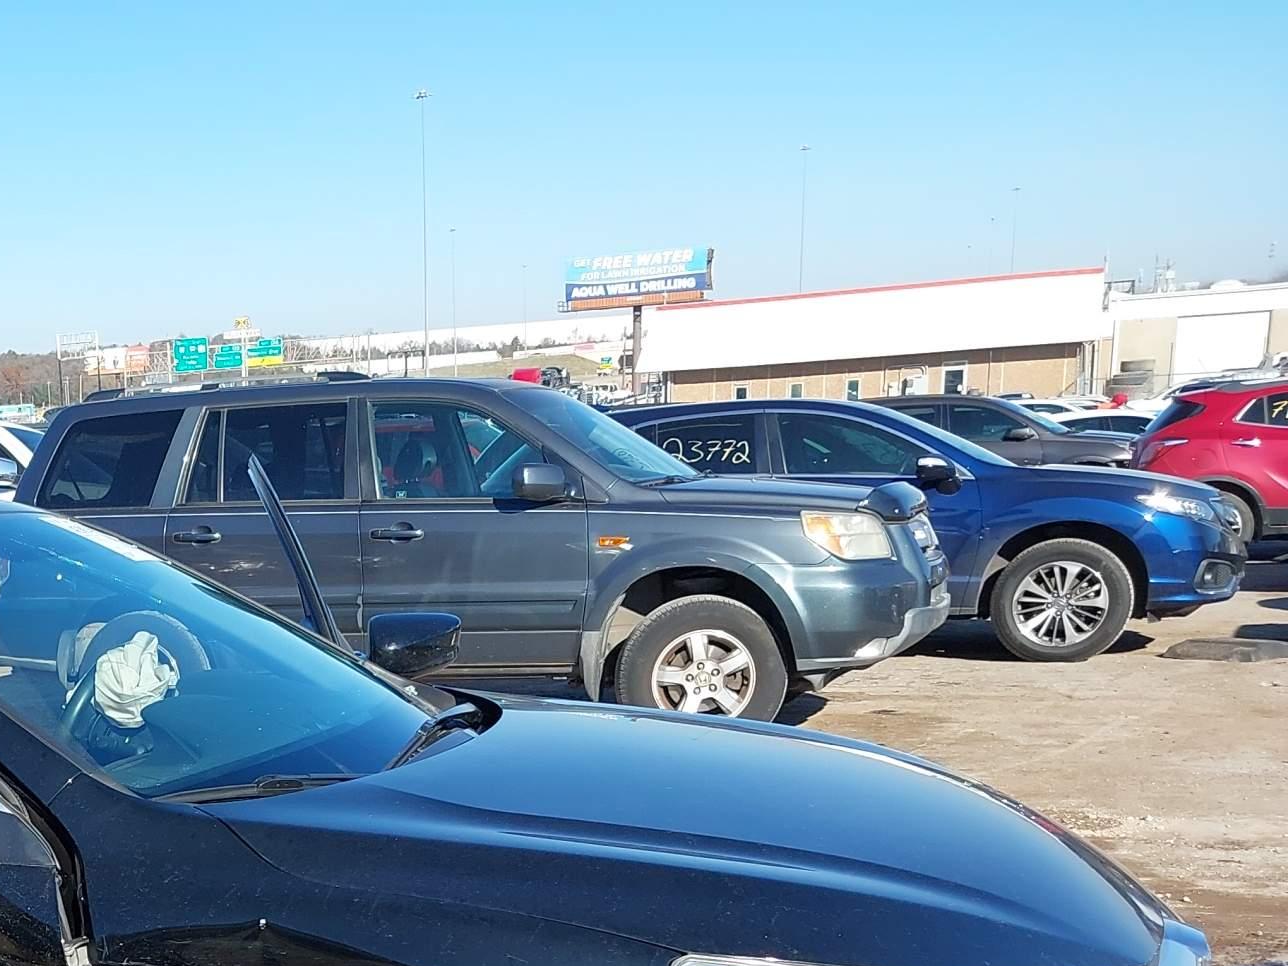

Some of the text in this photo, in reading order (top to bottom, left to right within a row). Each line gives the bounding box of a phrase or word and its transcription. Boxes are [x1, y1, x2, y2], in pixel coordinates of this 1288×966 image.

[592, 255, 632, 270] FREE
[637, 249, 693, 265] WATER
[571, 277, 696, 298] AQUA WELL DRILLING
[662, 437, 751, 464] 23772
